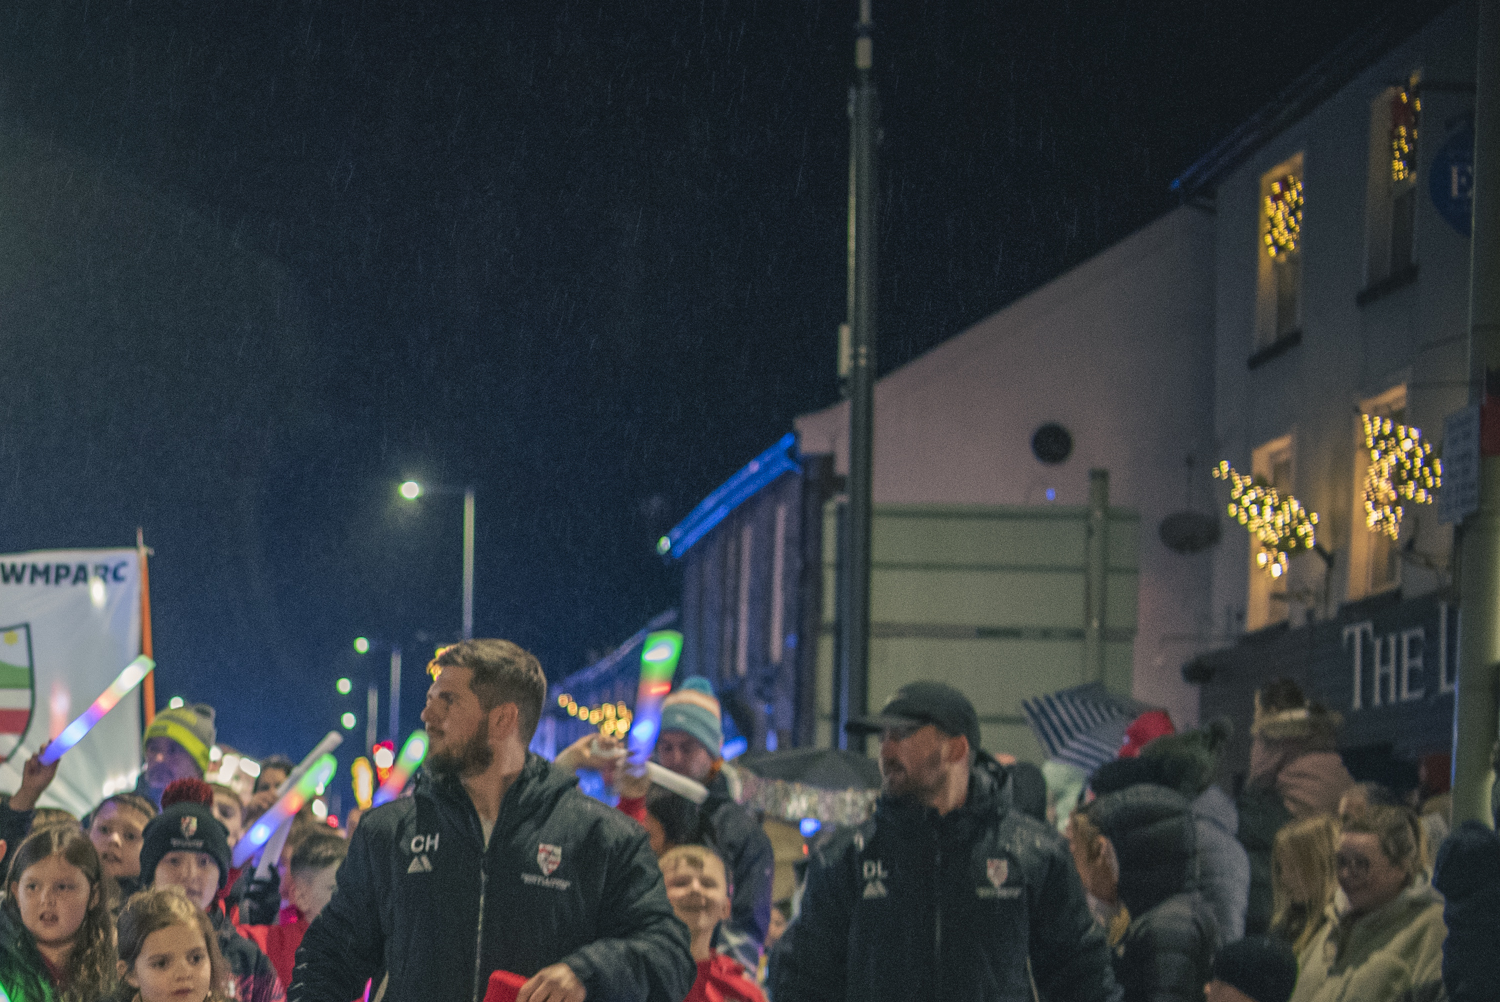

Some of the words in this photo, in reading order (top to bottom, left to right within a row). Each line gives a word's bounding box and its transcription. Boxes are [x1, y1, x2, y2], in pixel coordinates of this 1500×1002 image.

[1342, 619, 1425, 710] THE
[410, 833, 439, 853] CH
[863, 859, 888, 879] DL
